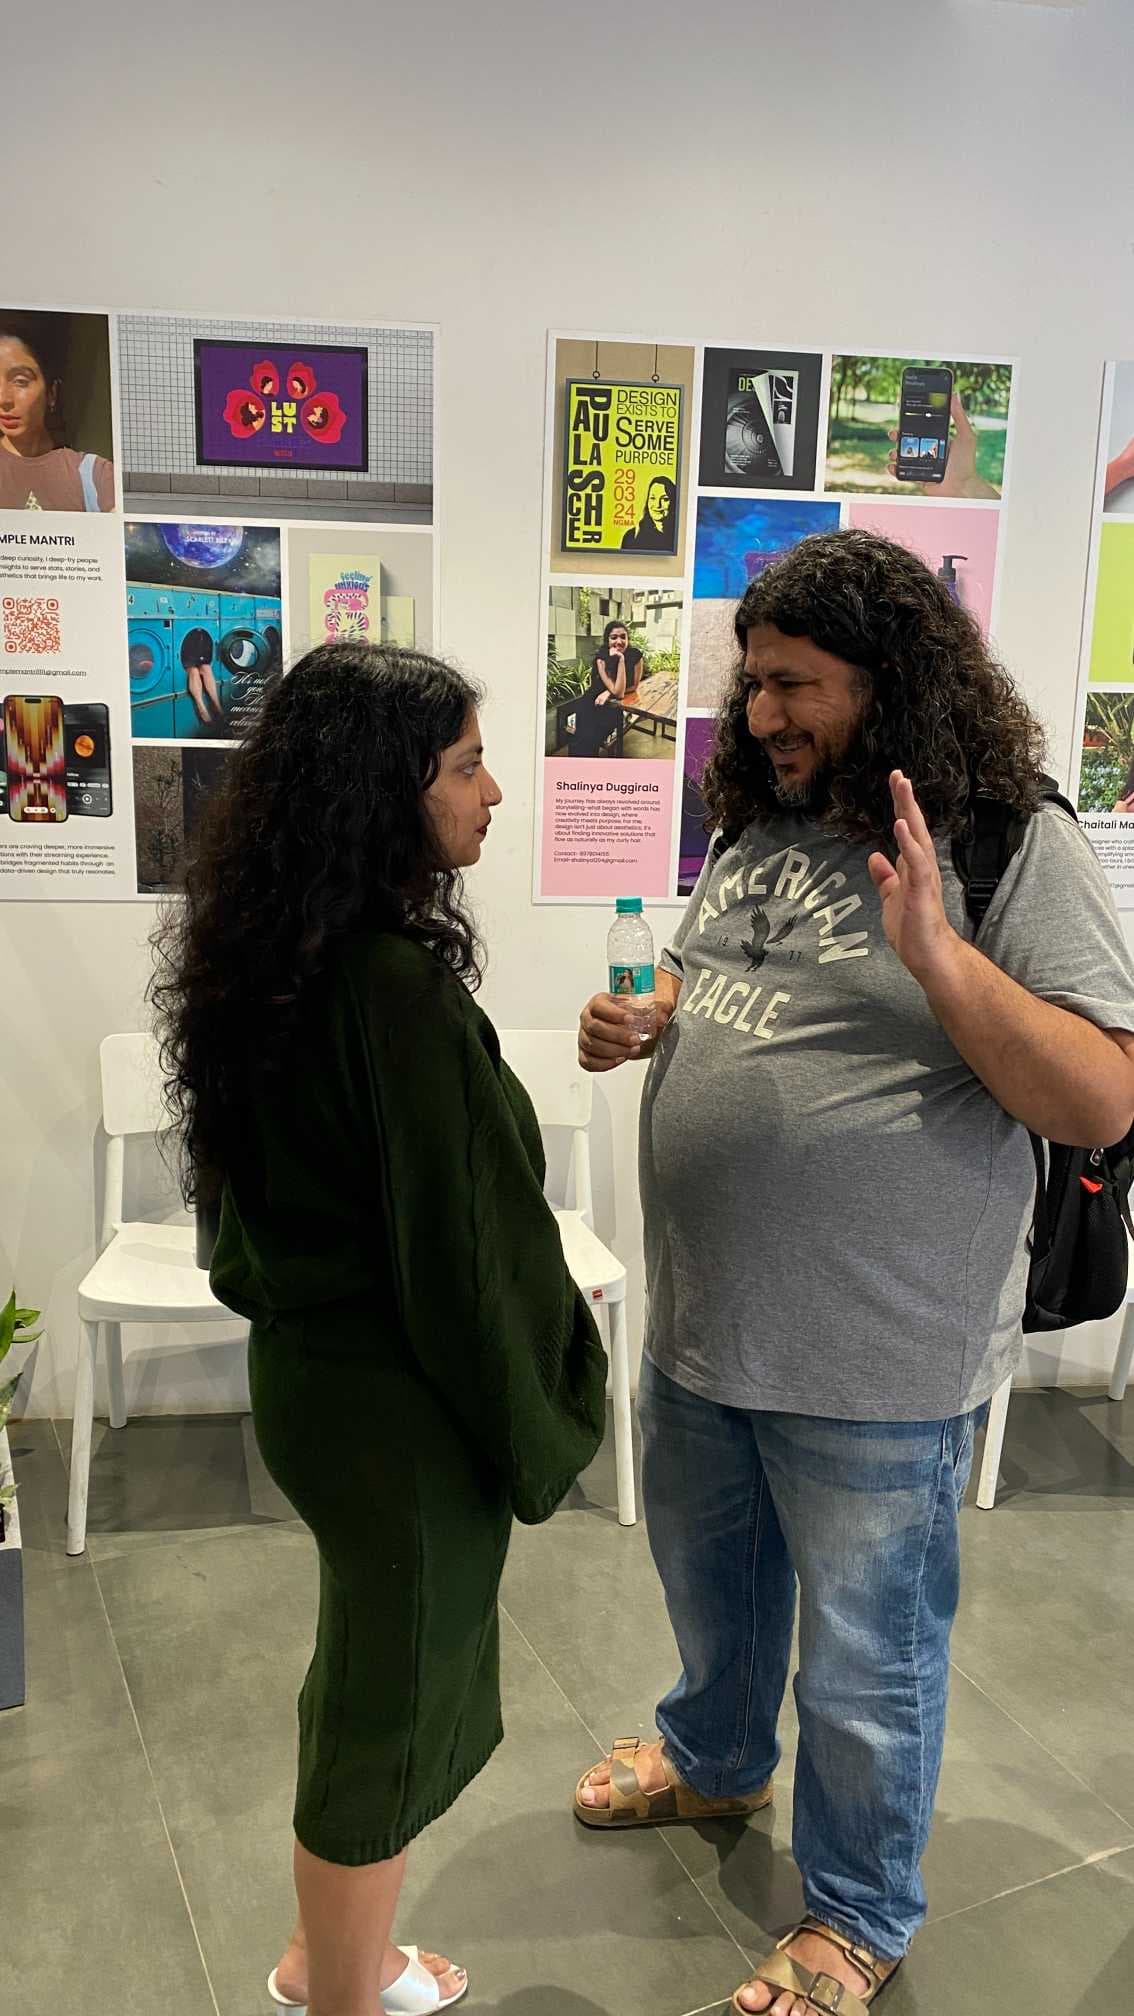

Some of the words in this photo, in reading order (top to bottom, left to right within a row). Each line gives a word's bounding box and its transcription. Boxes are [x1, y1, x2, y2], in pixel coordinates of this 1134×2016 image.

[617, 389, 677, 407] DESIGN
[616, 404, 658, 417] EXISTS
[660, 407, 677, 419] TO
[615, 450, 674, 466] PURPOSE
[614, 469, 636, 485] 29
[613, 486, 635, 502] 03
[613, 503, 636, 519] 24
[29, 535, 75, 546] MANTRI
[556, 781, 604, 793] Shalinya
[606, 782, 659, 794] Duggirala
[698, 848, 869, 964] AMERICAN
[682, 968, 792, 1041] EAGLE
